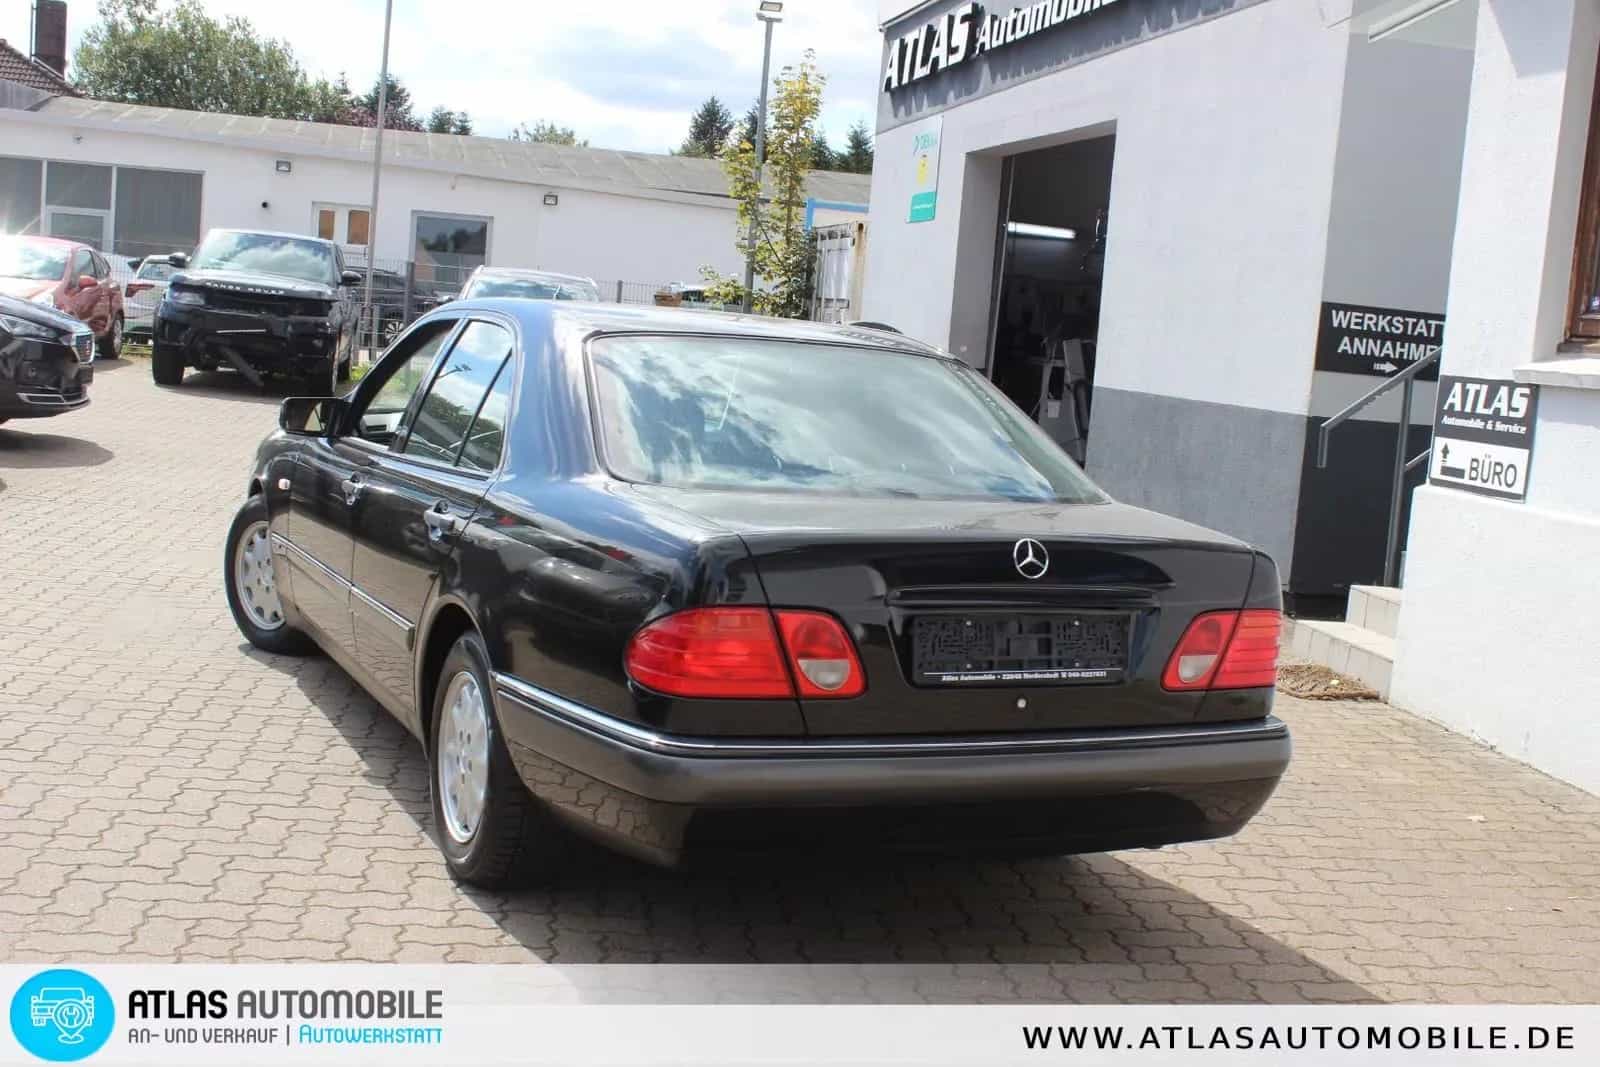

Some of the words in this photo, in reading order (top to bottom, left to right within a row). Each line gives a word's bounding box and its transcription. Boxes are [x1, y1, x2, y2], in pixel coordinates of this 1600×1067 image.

[883, 3, 975, 92] ATLAS
[976, 0, 1118, 54] Automo
[1443, 382, 1530, 418] ATLAS
[1441, 415, 1485, 429] Automobile
[1494, 421, 1527, 434] Service
[1468, 454, 1517, 488] BÜRO
